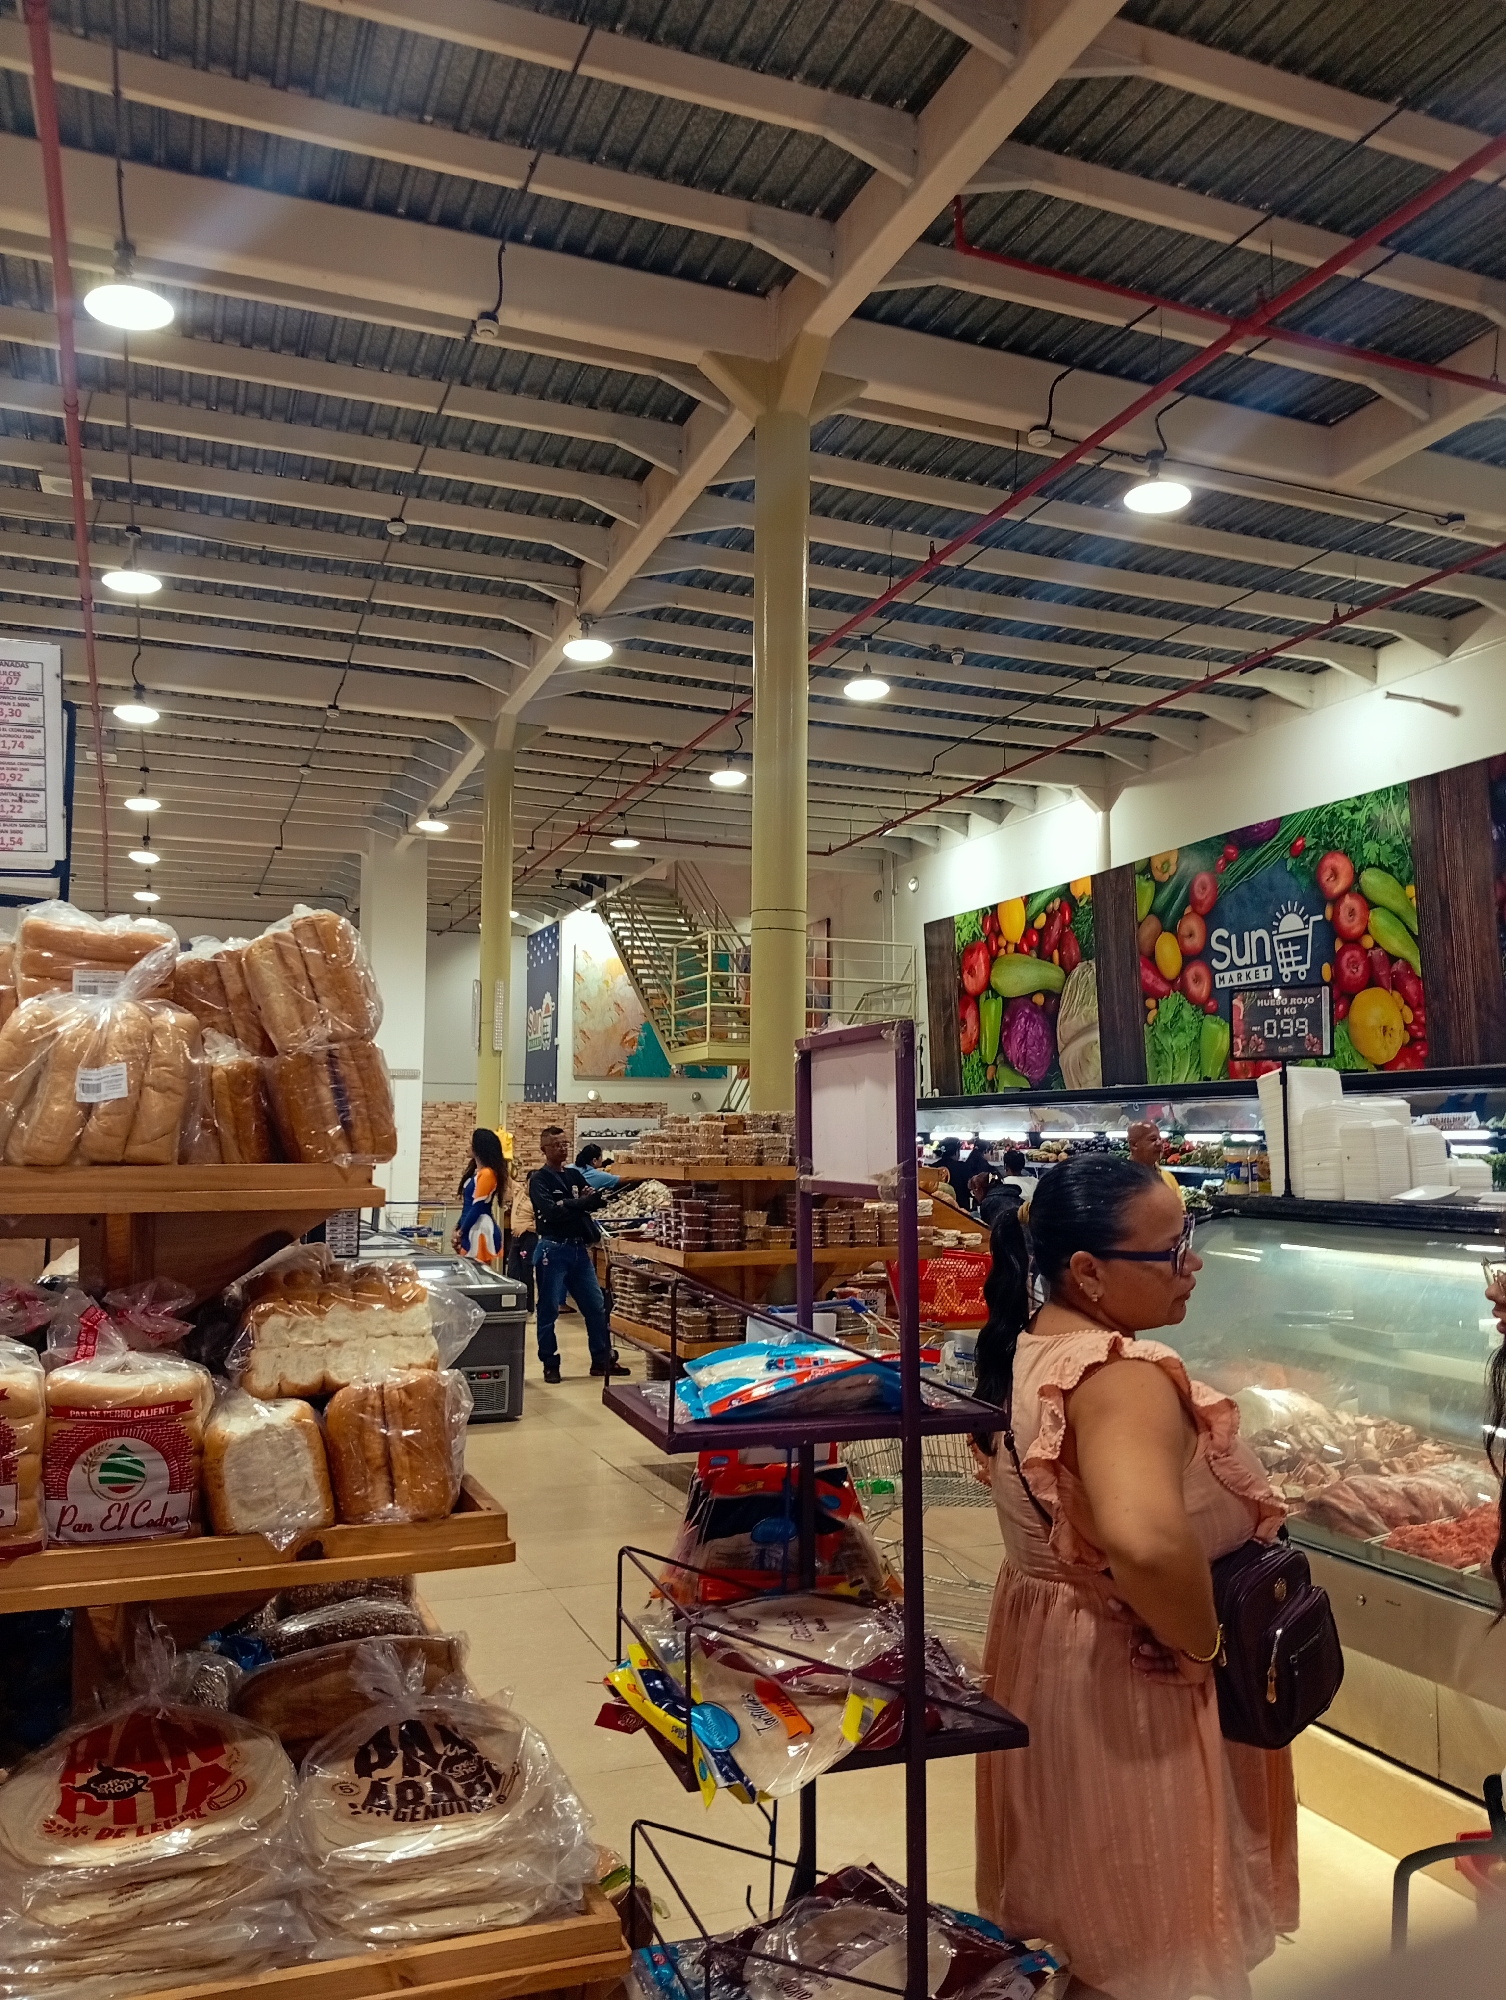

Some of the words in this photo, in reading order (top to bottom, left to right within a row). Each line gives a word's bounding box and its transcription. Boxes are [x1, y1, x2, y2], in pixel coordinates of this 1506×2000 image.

[0, 676, 20, 687] ,07
[1, 740, 25, 750] 1,74
[0, 772, 24, 783] 0,92
[0, 804, 23, 815] 1,22
[0, 836, 24, 847] 1,54
[1210, 927, 1272, 970] Sun
[1218, 967, 1270, 986] MARKET
[1289, 996, 1315, 1006] ROJO
[1275, 1007, 1281, 1016] X
[1283, 1007, 1297, 1015] KG
[1264, 1017, 1309, 1039] 0,99
[70, 1410, 88, 1418] PAN
[89, 1410, 101, 1418] DE
[103, 1409, 132, 1418] PERRO
[133, 1404, 176, 1418] CALIENTE
[55, 1504, 95, 1539] Pan
[100, 1502, 130, 1532] El
[58, 1713, 227, 1785] PAN
[95, 1826, 129, 1841] DE
